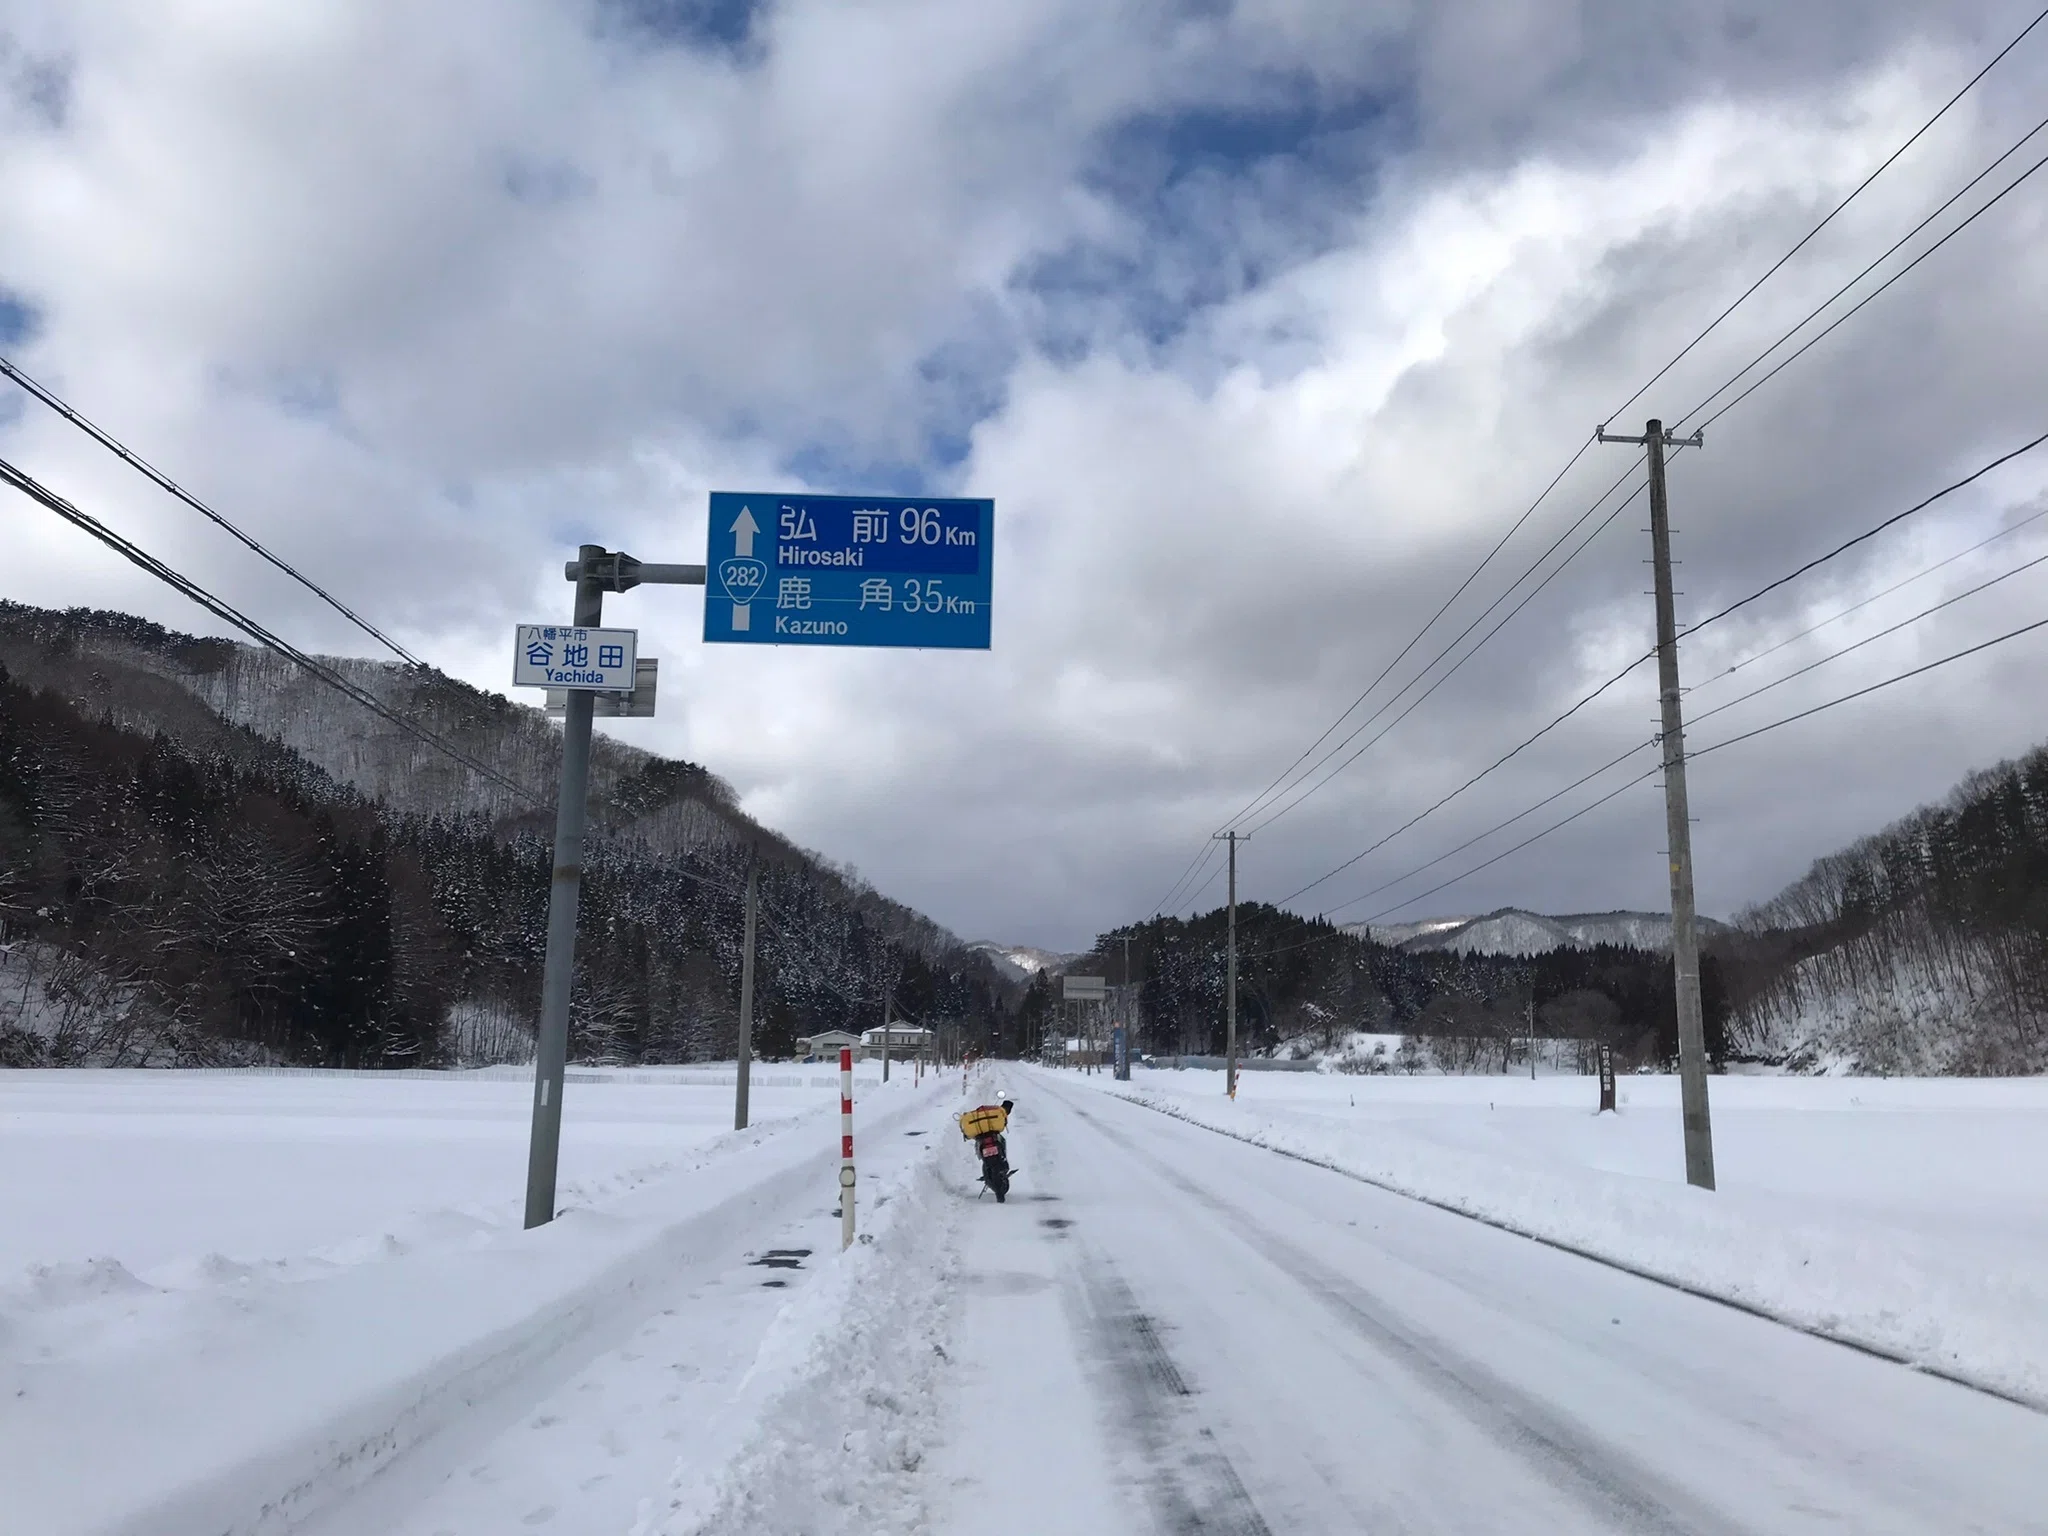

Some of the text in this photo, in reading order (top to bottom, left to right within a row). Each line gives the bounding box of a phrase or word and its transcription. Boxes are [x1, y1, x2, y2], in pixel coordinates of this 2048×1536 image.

[899, 507, 941, 545] 96
[945, 527, 976, 546] Km
[778, 546, 864, 567] Hirosaki
[726, 566, 759, 587] 282
[902, 578, 944, 614] 35
[946, 595, 976, 615] Km
[528, 627, 588, 641] 八幡平市
[775, 616, 848, 635] Kazuno
[526, 642, 623, 668] 谷地田
[545, 669, 604, 684] Yachida
